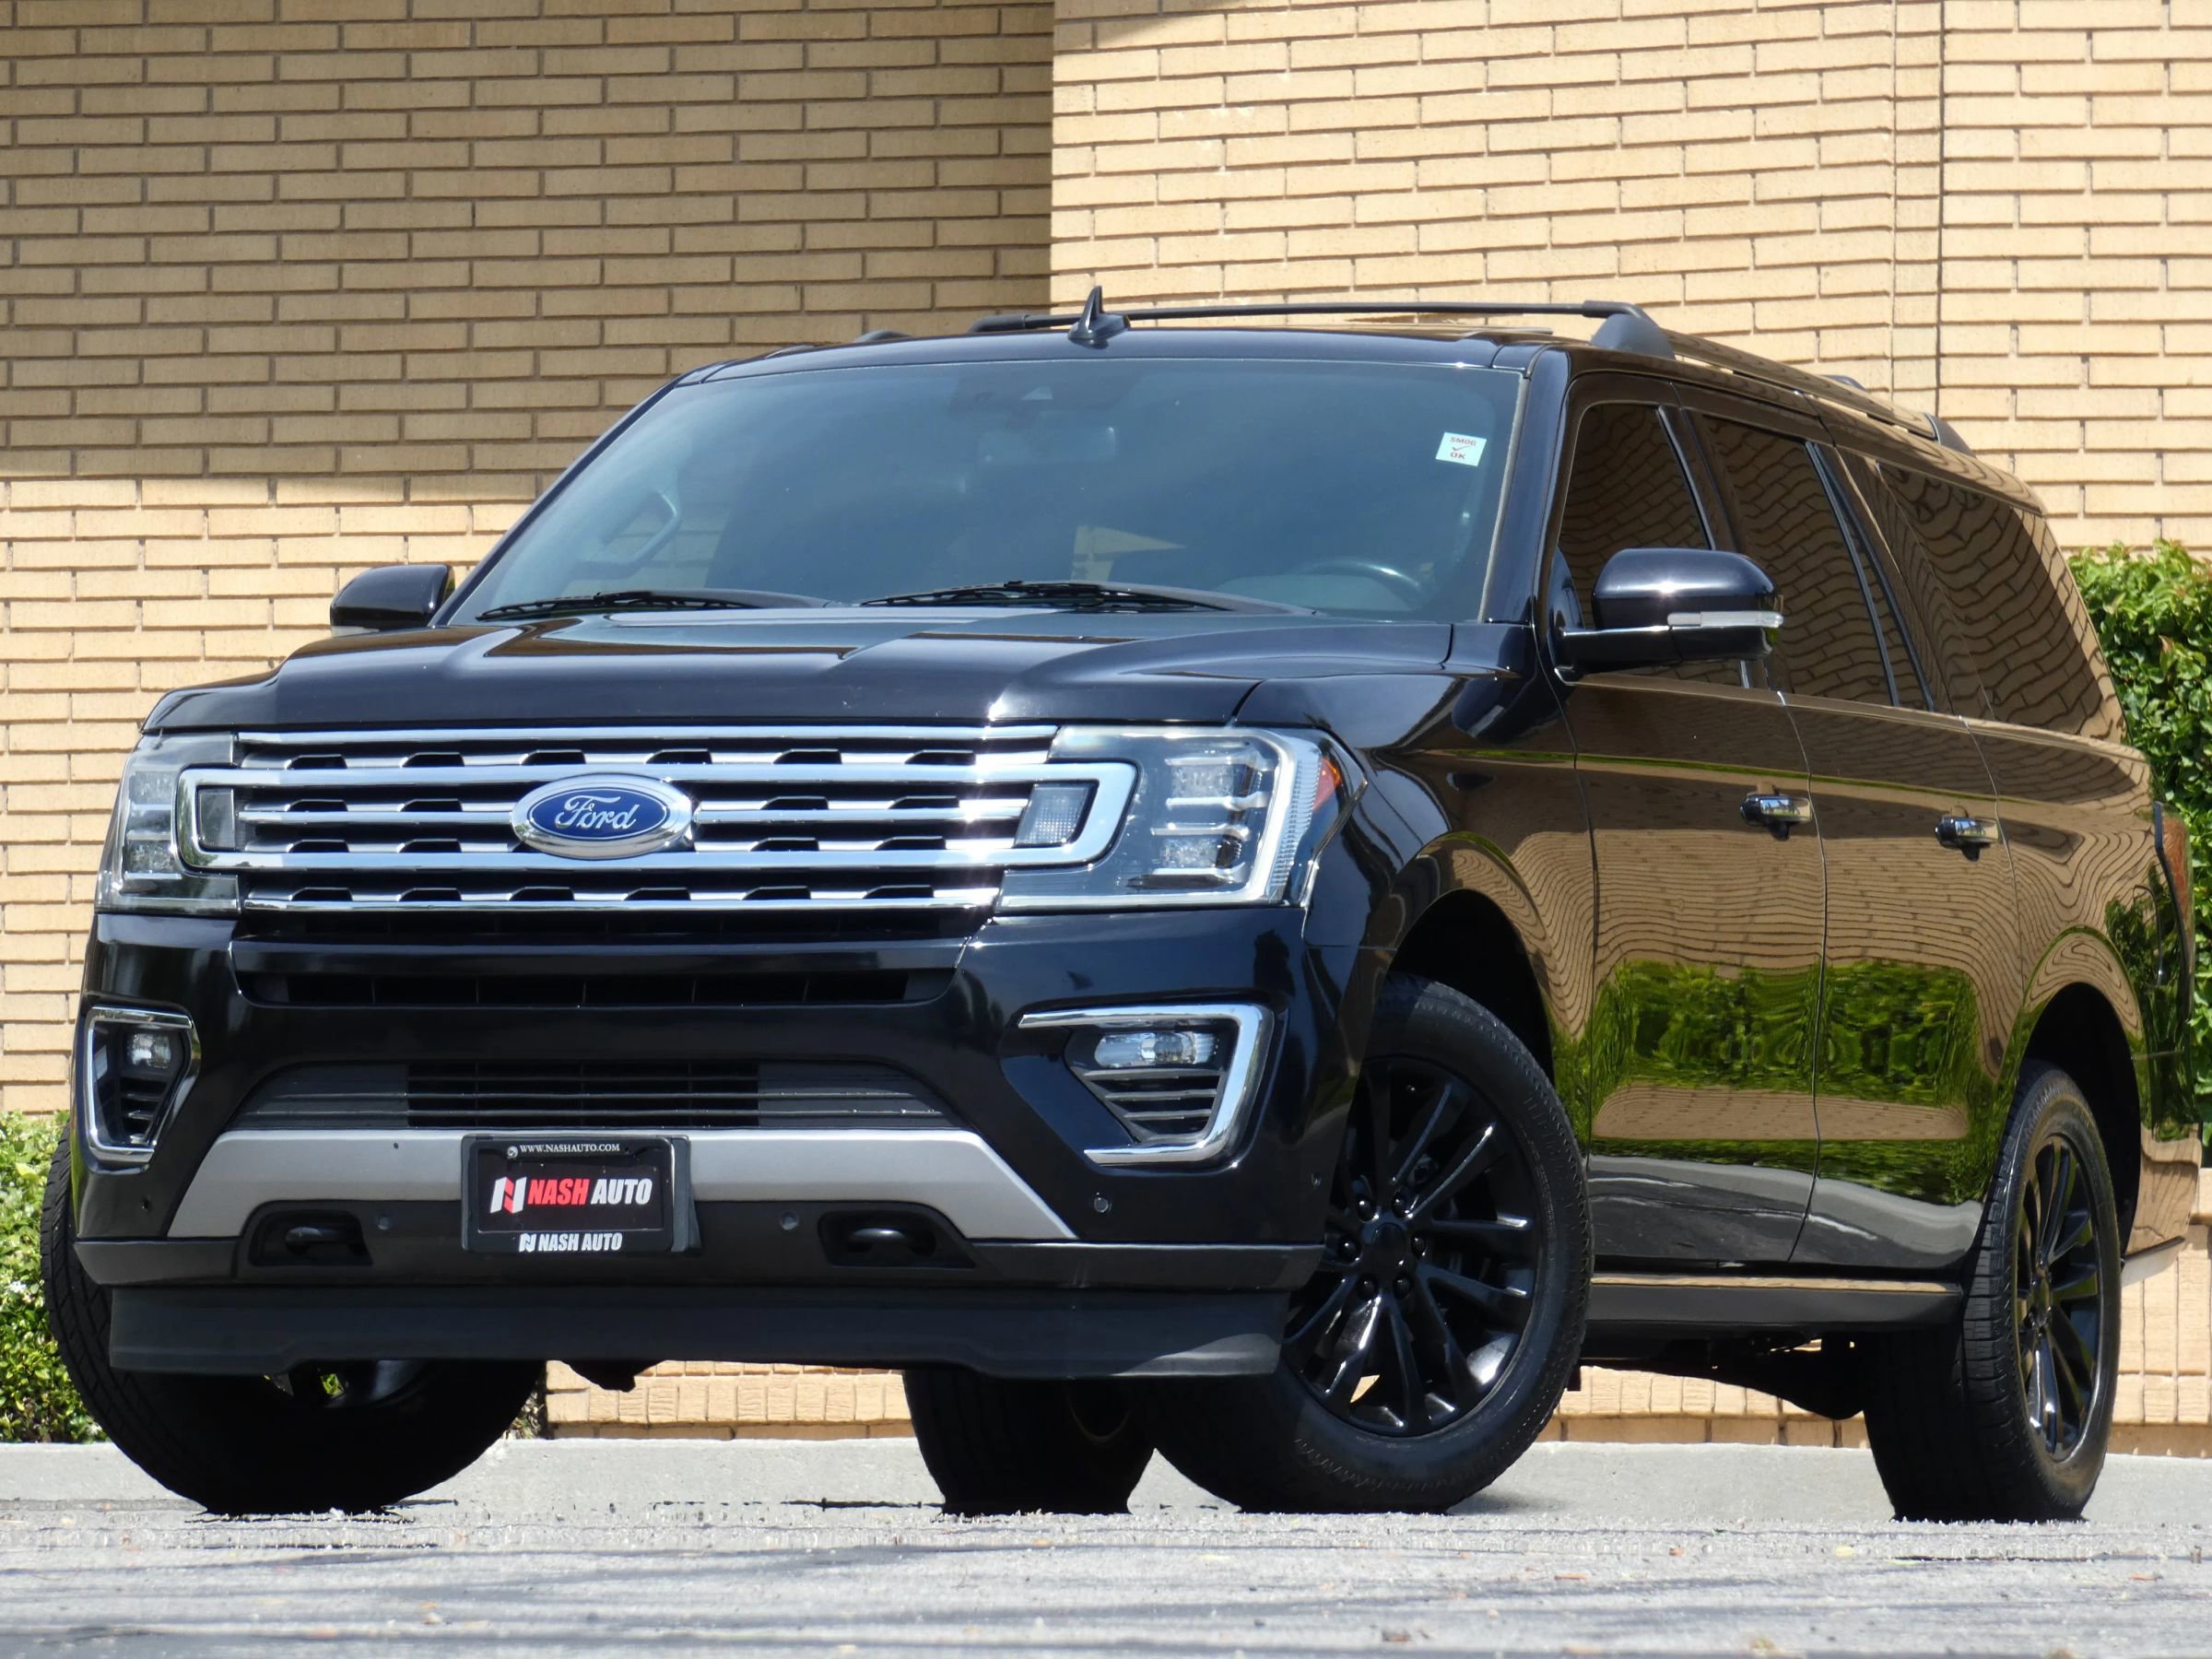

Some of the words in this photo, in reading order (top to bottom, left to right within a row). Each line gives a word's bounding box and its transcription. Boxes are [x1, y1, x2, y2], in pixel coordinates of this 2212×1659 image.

[1450, 437, 1477, 446] SMOG
[1450, 452, 1465, 460] OK
[555, 794, 640, 830] Ford
[520, 1144, 620, 1152] WWW.NASHAUTO.COM
[527, 1178, 590, 1205] NASH
[591, 1178, 653, 1205] AUTO
[538, 1233, 579, 1252] NASH
[582, 1232, 623, 1251] AUTO
